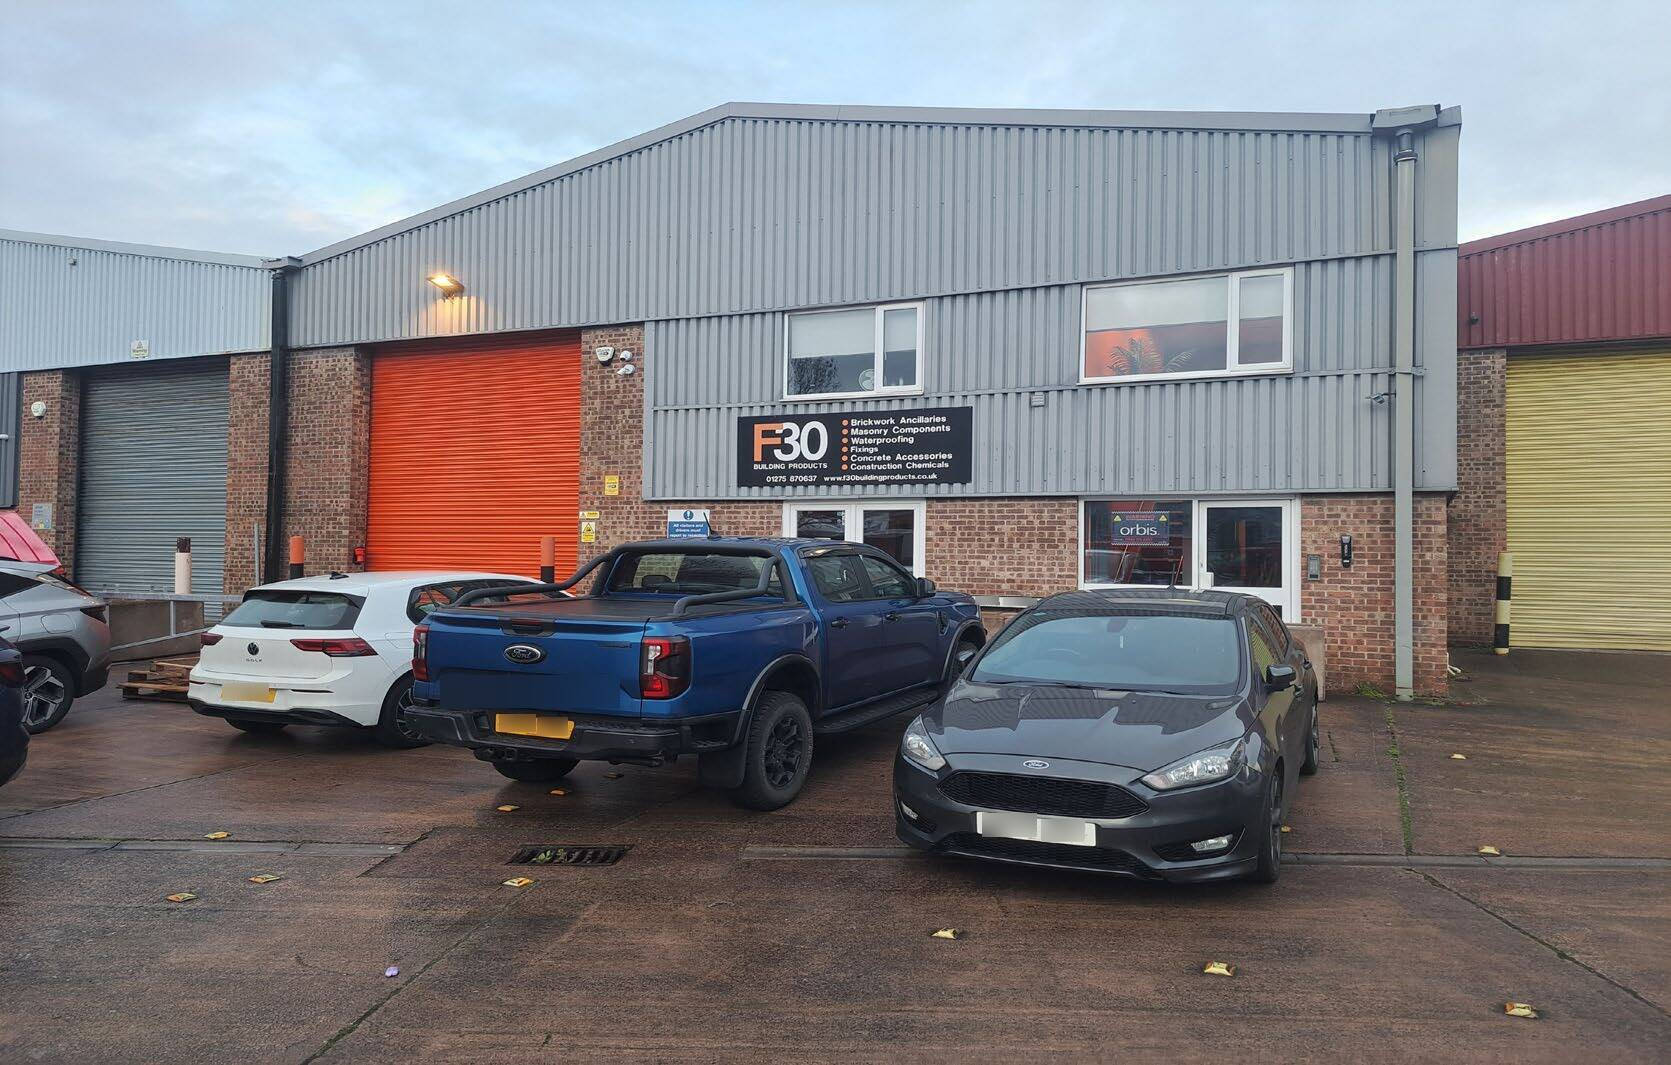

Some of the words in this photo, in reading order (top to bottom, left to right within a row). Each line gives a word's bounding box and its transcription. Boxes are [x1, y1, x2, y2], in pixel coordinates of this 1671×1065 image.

[850, 417, 895, 426] Brickwork
[900, 415, 947, 424] Ancillaries
[850, 428, 889, 436] Masonry
[892, 425, 951, 434] Components
[753, 420, 828, 462] F30
[850, 435, 914, 445] Waterproofing
[850, 446, 879, 454] Fixings
[850, 454, 891, 462] Concrete
[895, 451, 953, 461] Accessories
[850, 463, 902, 471] Construction
[905, 461, 950, 469] Chemicals
[766, 475, 787, 483] 01275
[789, 475, 818, 483] 870637
[823, 472, 938, 482] www.f30buildingproducts.co.uk
